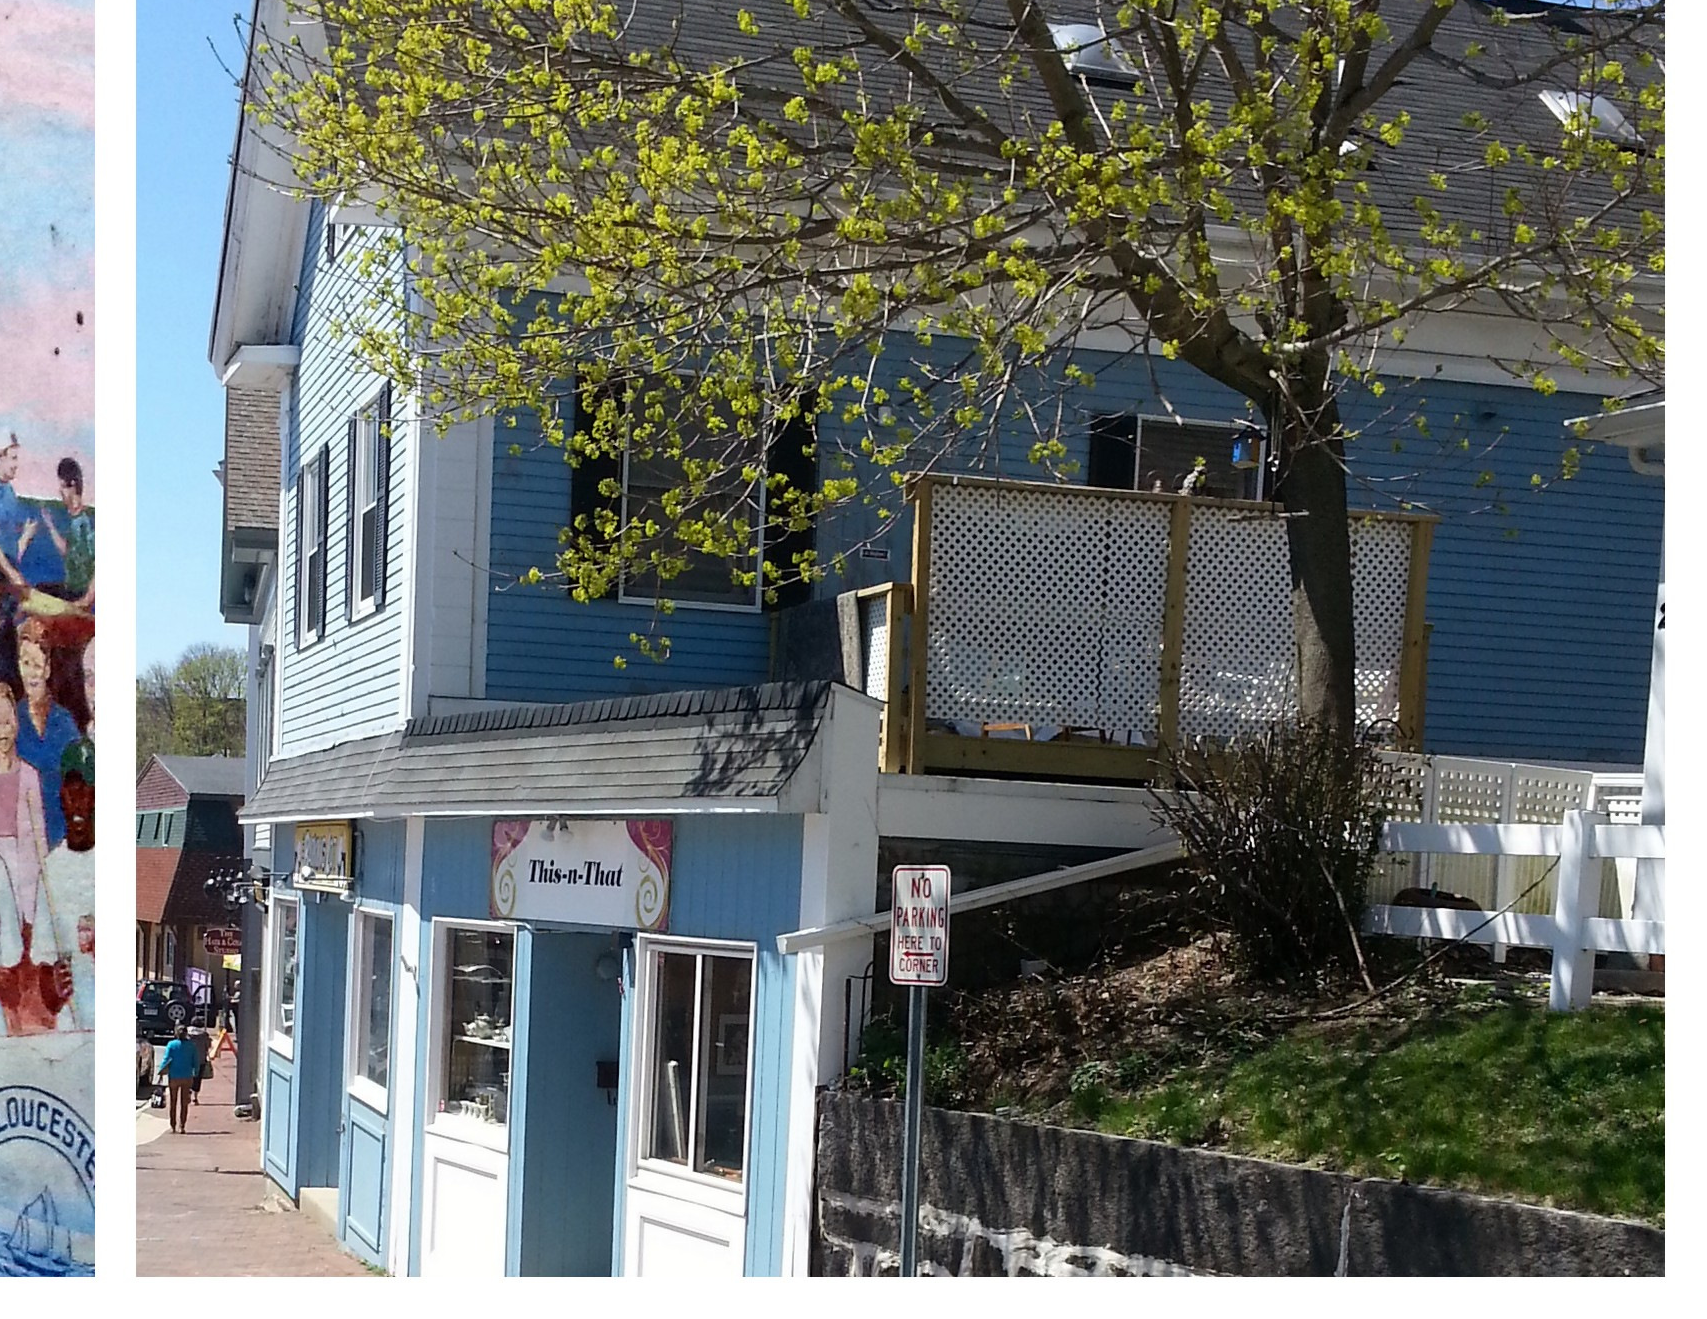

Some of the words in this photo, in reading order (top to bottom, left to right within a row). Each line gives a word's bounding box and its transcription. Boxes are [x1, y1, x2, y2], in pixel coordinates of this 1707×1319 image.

[529, 859, 623, 887] This-n-That
[911, 877, 931, 898] NO
[896, 906, 944, 928] PARKING
[897, 935, 923, 950] HERE
[930, 936, 941, 951] TO
[899, 958, 938, 973] CORNER
